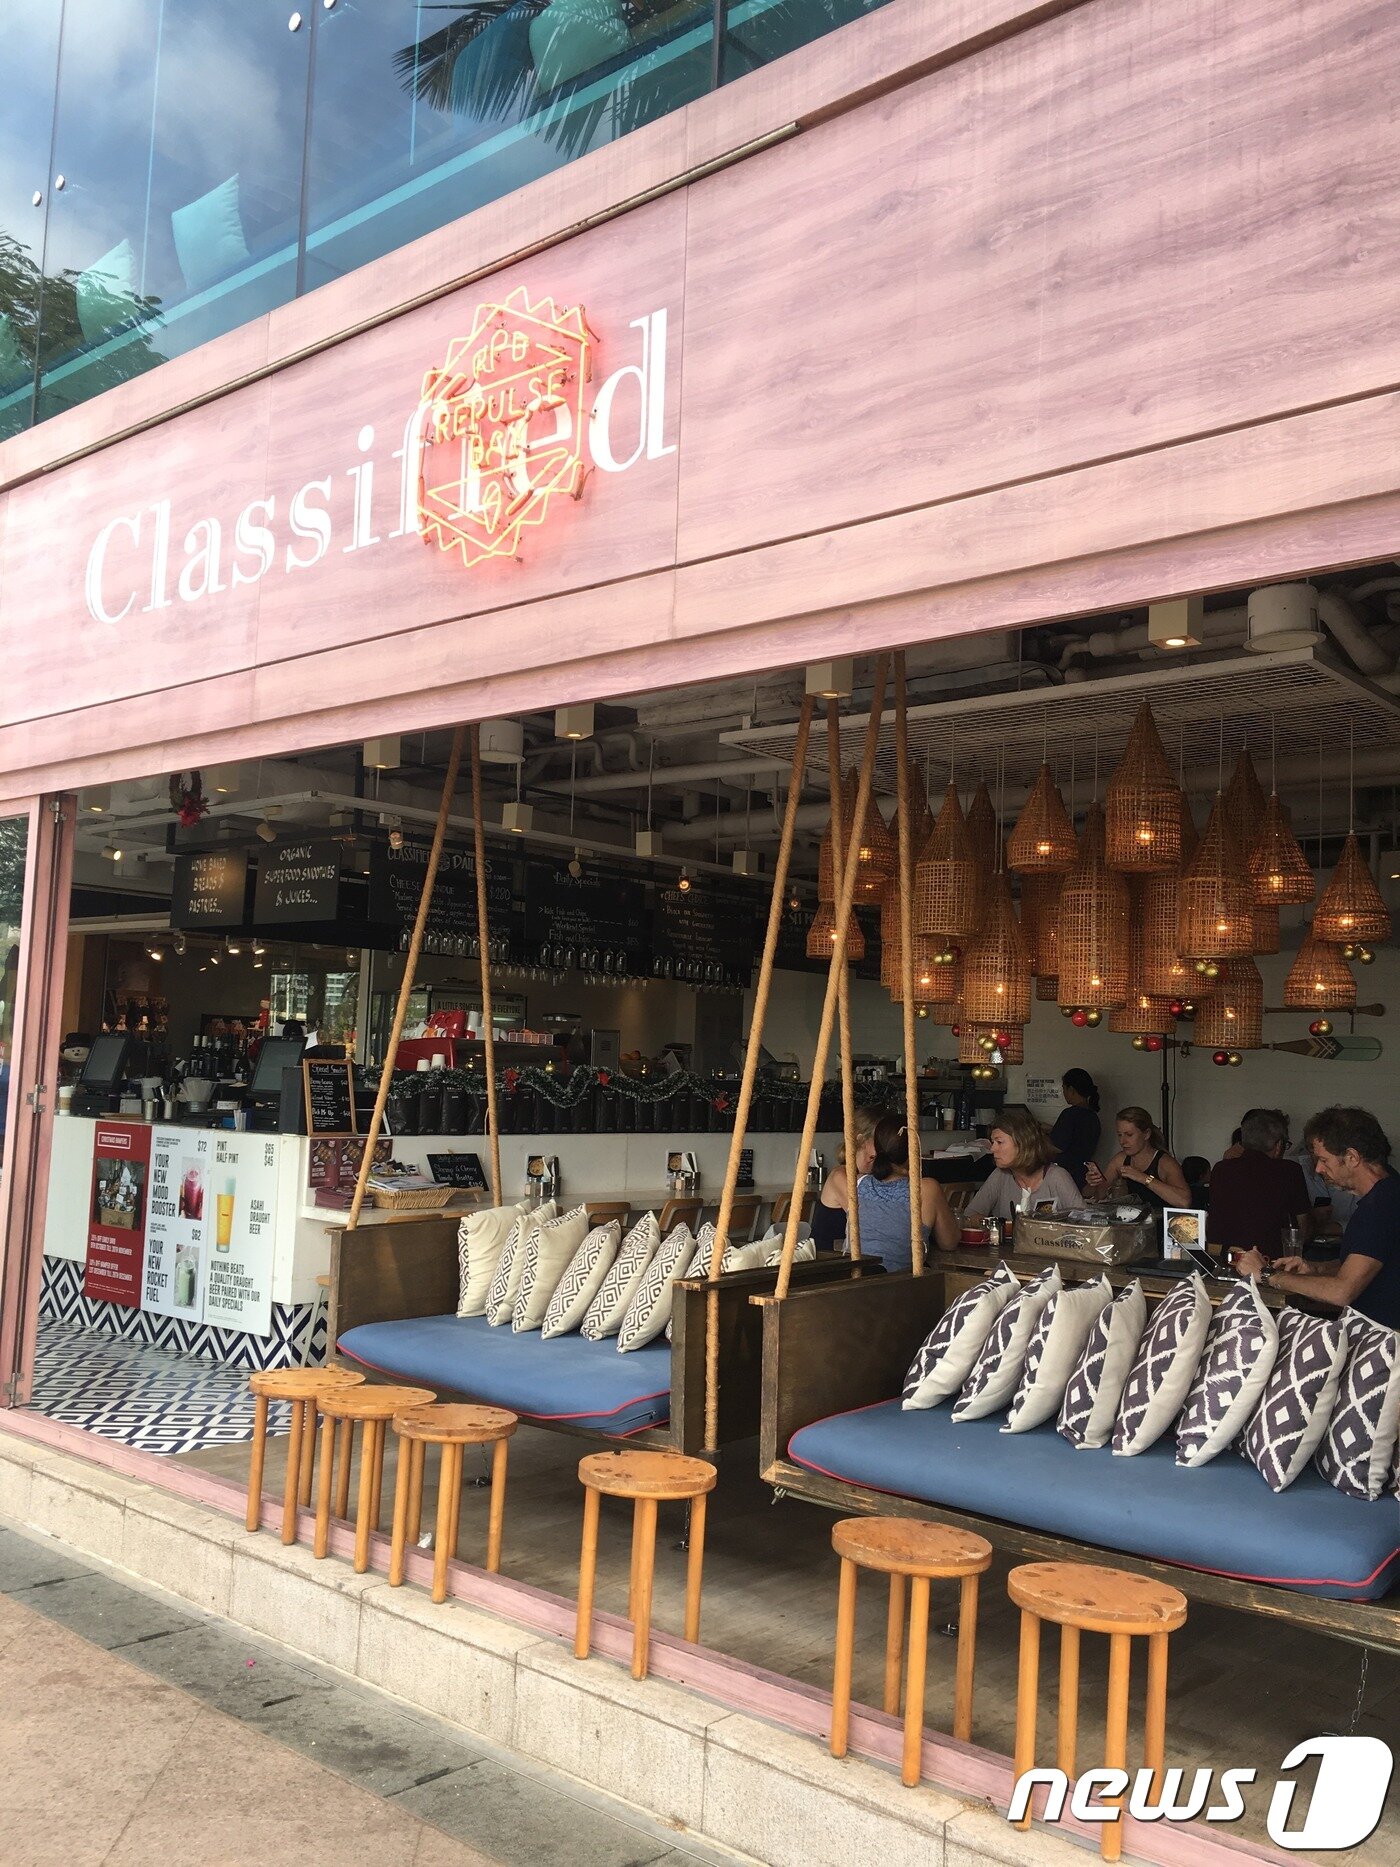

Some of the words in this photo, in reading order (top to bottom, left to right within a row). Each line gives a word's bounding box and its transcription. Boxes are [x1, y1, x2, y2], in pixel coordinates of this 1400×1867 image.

[436, 368, 569, 444] REPULSE
[85, 307, 677, 625] Classified
[279, 845, 313, 862] ORGANIC
[301, 864, 336, 882] SMOOTHIES
[193, 877, 217, 892] BREADS
[275, 890, 283, 907] &
[197, 1140, 207, 1152] $72
[216, 1140, 227, 1152] PINT
[154, 1153, 169, 1168] YOUR
[216, 1152, 228, 1163] HALF
[228, 1153, 239, 1165] PINT
[264, 1154, 274, 1167] $45
[153, 1169, 168, 1183] NEW
[152, 1184, 169, 1200] MOOD
[151, 1200, 176, 1218] BOOSTER
[250, 1199, 264, 1211] ASAHI
[250, 1211, 270, 1225] DRAUGHT
[191, 1228, 202, 1241] $62
[249, 1222, 261, 1235] BEER
[149, 1239, 164, 1255] YOUR
[147, 1254, 161, 1271] NEW
[210, 1260, 230, 1274] NOTHING
[230, 1263, 245, 1275] BEATS
[146, 1270, 168, 1288] ROCKET
[209, 1271, 214, 1282] A
[214, 1273, 234, 1286] QUALITY
[234, 1275, 254, 1289] DRAUGHT
[145, 1286, 160, 1303] FUEL
[209, 1283, 222, 1296] BEER
[222, 1284, 238, 1298] PAIRED
[237, 1287, 251, 1300] WITH
[250, 1290, 261, 1303] OUR
[208, 1295, 222, 1308] DAILY
[221, 1297, 244, 1312] SPECIALS
